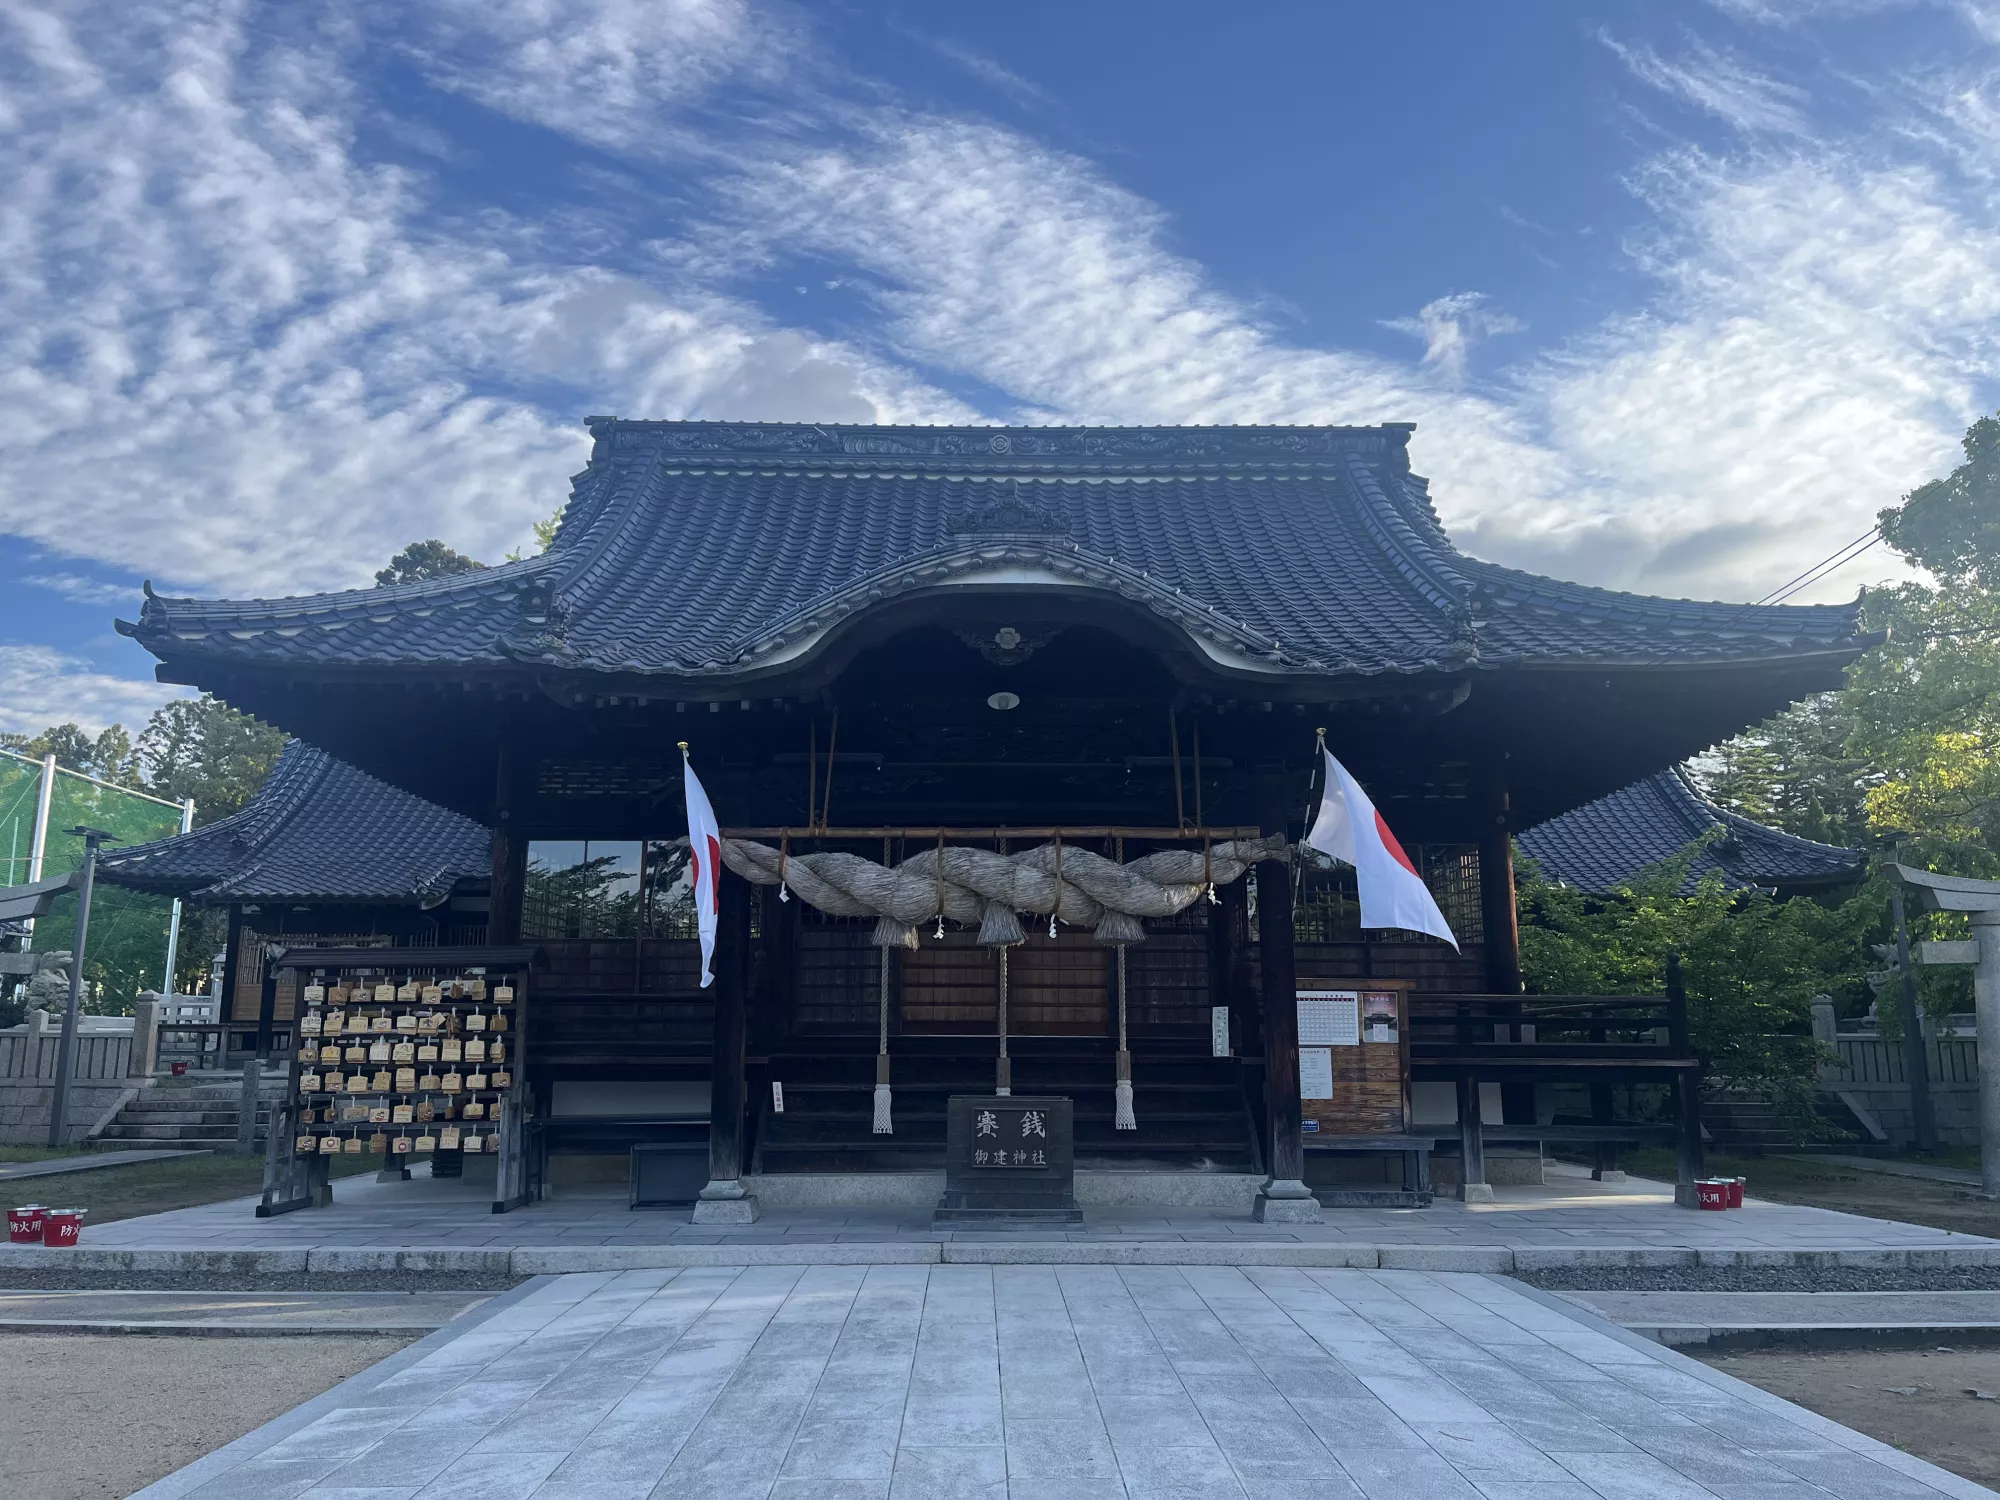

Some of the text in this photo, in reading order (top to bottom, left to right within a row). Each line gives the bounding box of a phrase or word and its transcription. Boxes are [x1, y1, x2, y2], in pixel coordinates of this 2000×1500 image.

[976, 1111, 1046, 1138] 賽銭
[974, 1149, 1046, 1165] 御建神社
[10, 1220, 42, 1233] 防火用
